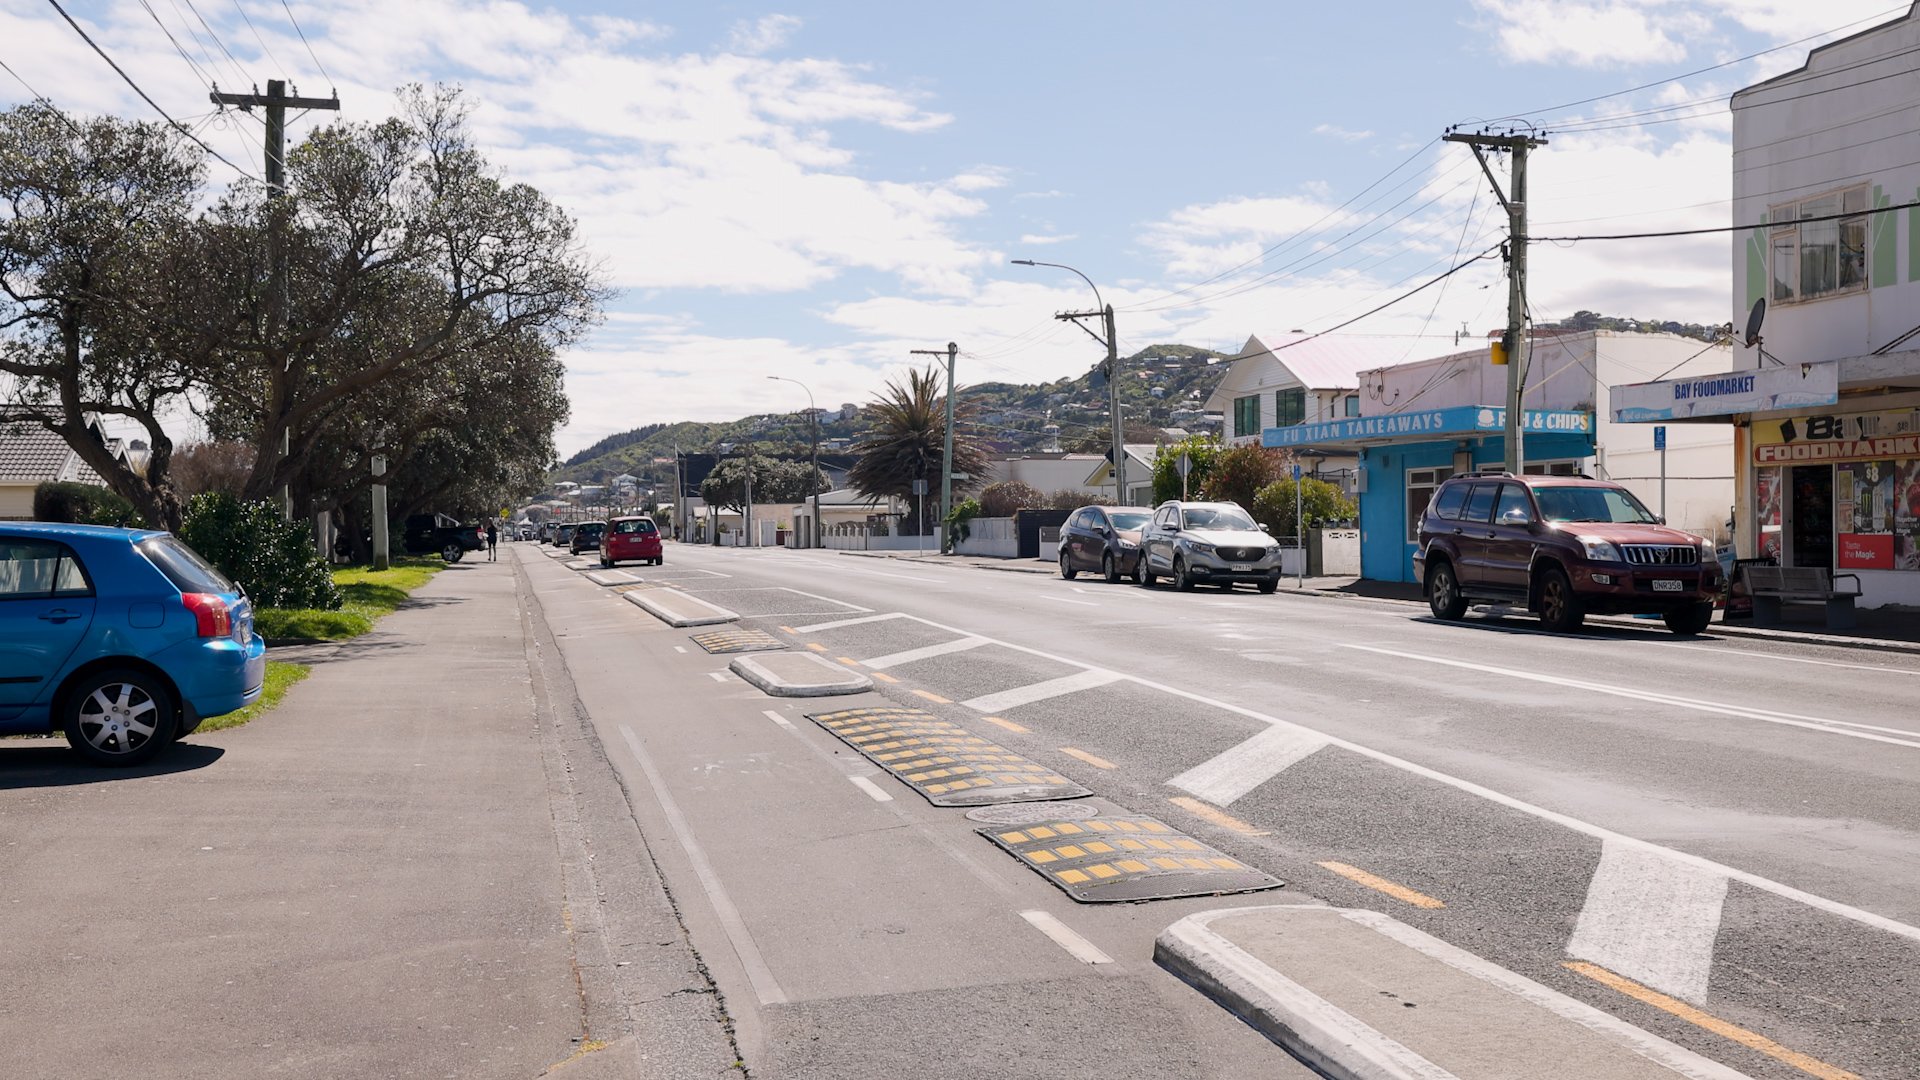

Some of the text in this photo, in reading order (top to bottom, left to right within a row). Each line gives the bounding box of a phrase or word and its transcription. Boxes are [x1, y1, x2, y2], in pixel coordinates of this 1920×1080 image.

[1675, 376, 1755, 399] BAY FOODMARKET
[1283, 412, 1443, 442] FU XIAN TAKEAWAYS
[1498, 411, 1588, 430] FH & CHIPS
[1759, 436, 1920, 462] FOODMARK
[1866, 466, 1879, 483] $8
[1855, 550, 1876, 560] Magic
[1653, 580, 1683, 590] DNR358
